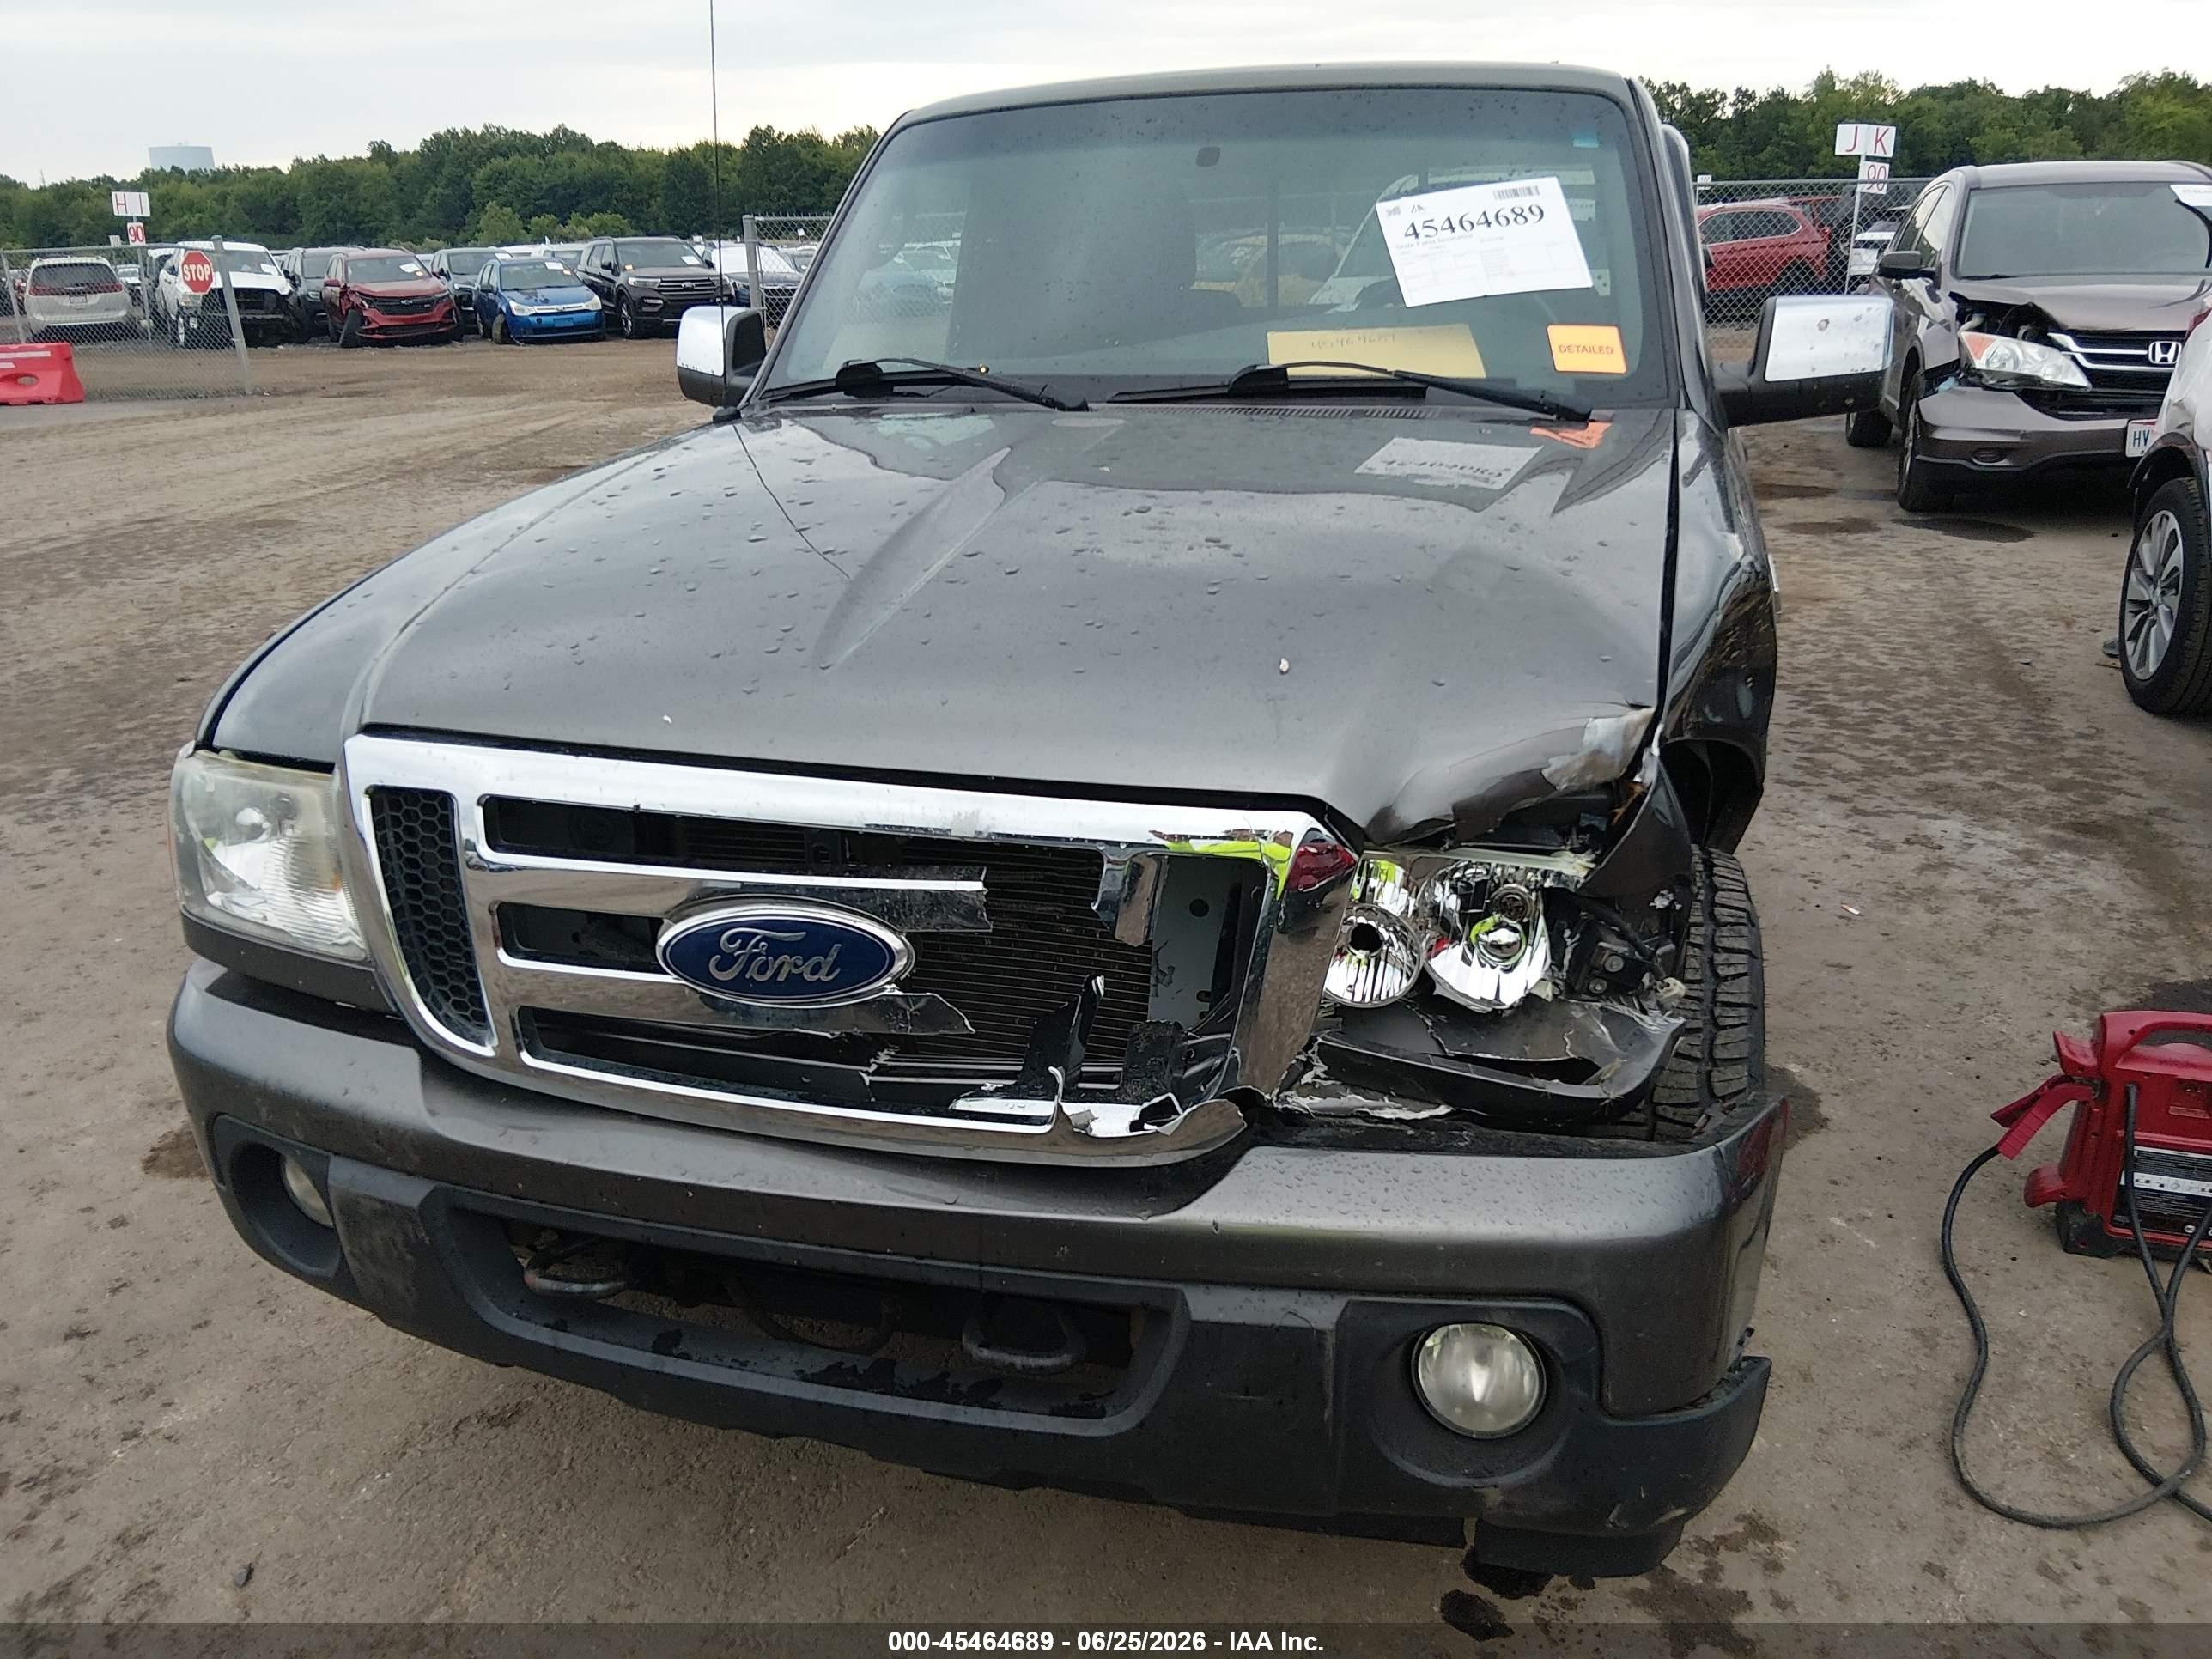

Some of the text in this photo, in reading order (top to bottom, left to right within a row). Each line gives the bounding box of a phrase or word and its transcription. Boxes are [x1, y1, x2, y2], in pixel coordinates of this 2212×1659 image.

[1845, 125, 1890, 155] J K
[114, 193, 128, 215] H
[1404, 204, 1545, 240] 45464689
[128, 226, 145, 243] 90
[183, 264, 211, 282] STOP
[1559, 344, 1614, 355] DETAILED
[708, 927, 842, 981] Ford
